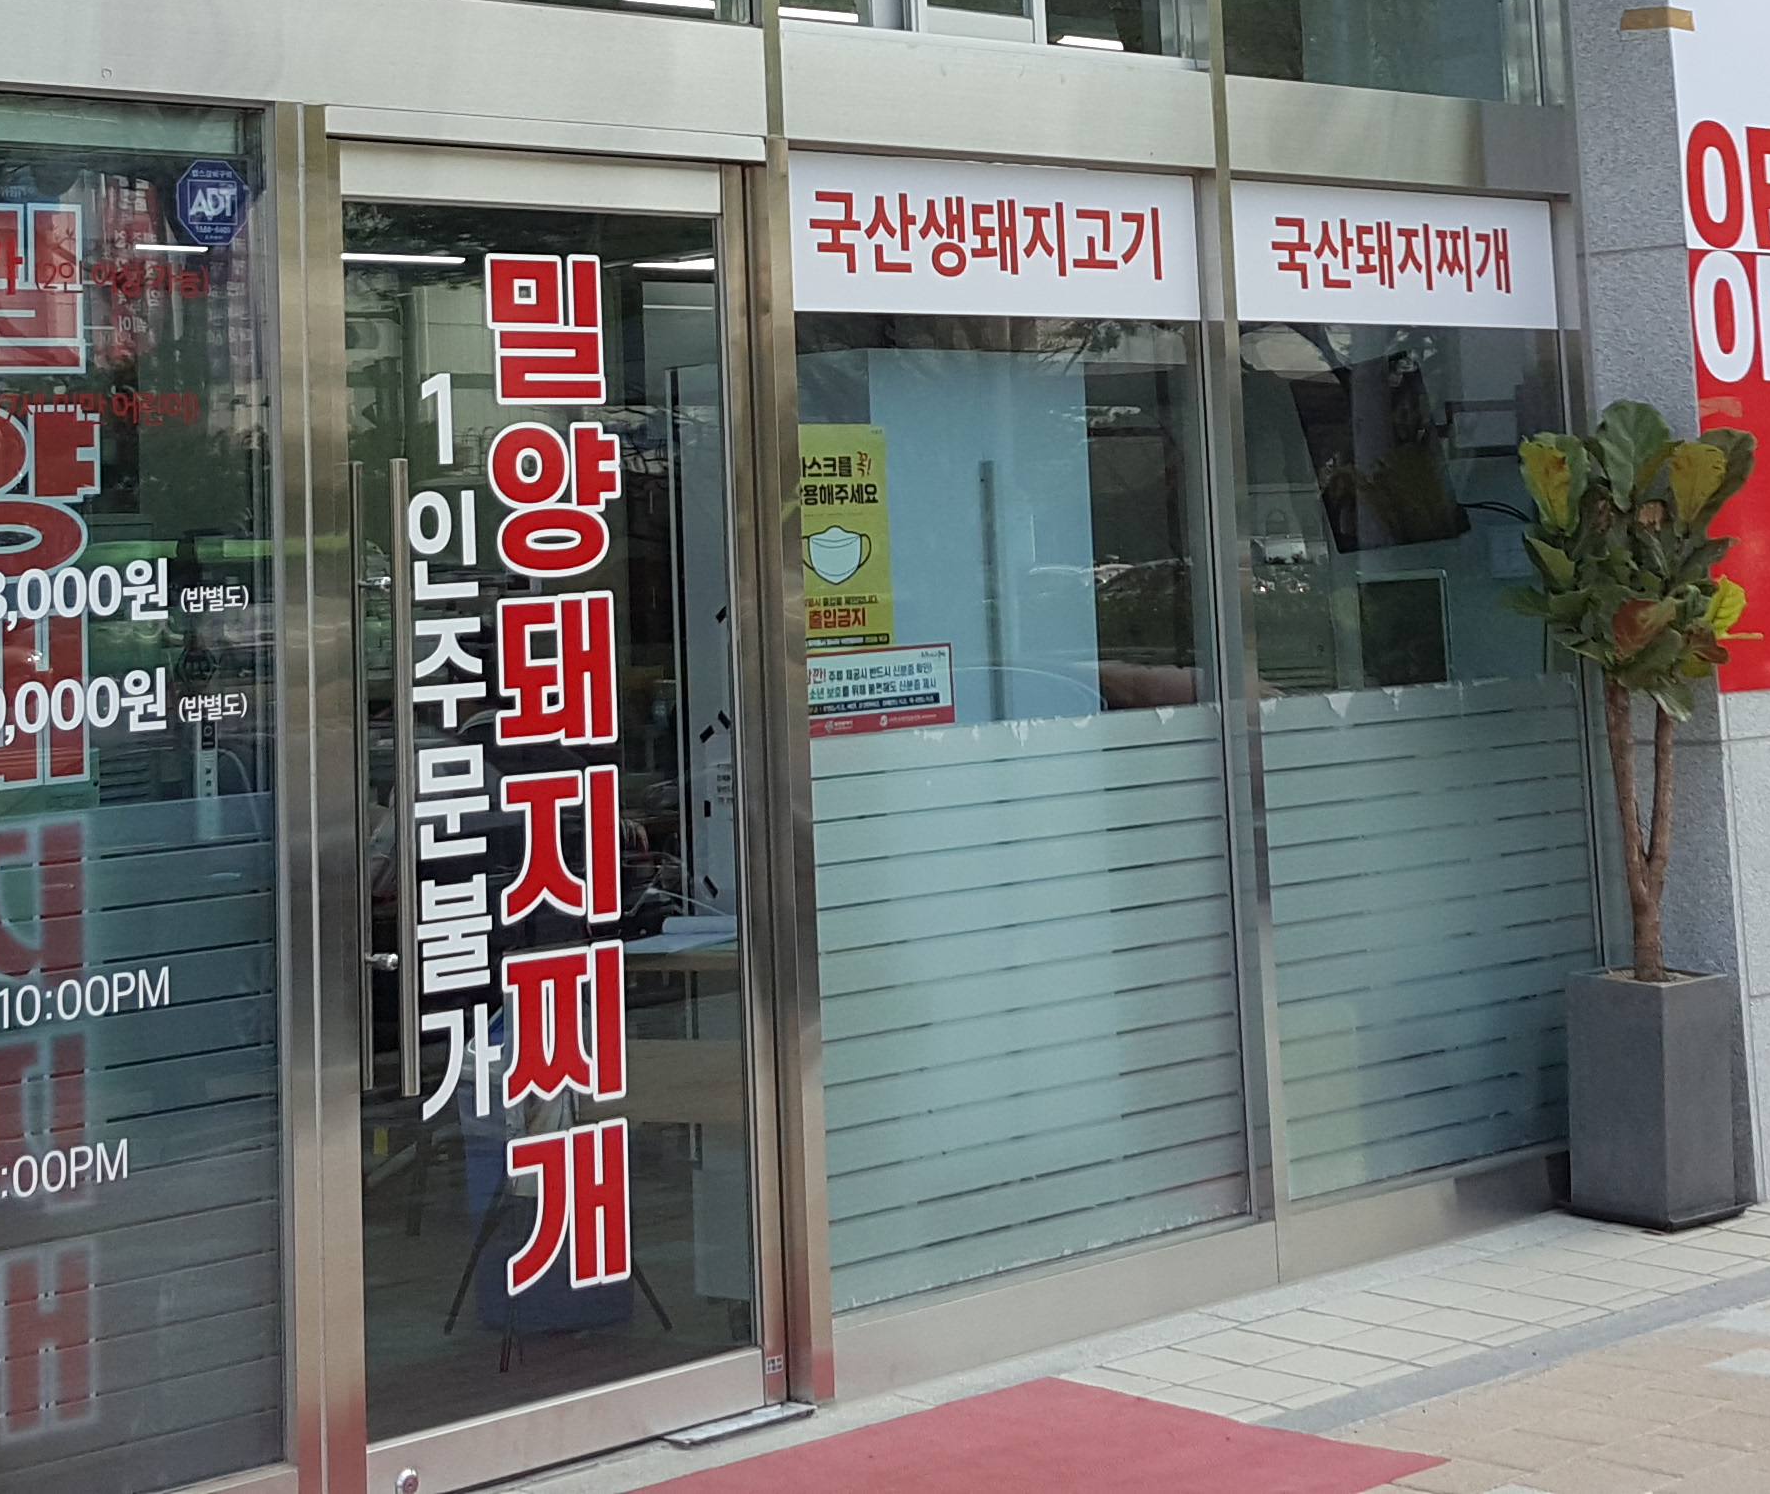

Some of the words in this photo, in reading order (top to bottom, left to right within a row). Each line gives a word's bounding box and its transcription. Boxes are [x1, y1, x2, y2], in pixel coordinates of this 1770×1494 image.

[189, 188, 236, 220] ADT
[809, 190, 1164, 281] 국산생돼지고기
[1271, 215, 1512, 294] 국산돼지찌개
[179, 579, 250, 613] (밥별도)
[809, 607, 866, 630] 출입금지
[178, 692, 249, 723] (밥별도)
[810, 687, 824, 700] 소년
[485, 253, 631, 1296] 밀양돼지찌개
